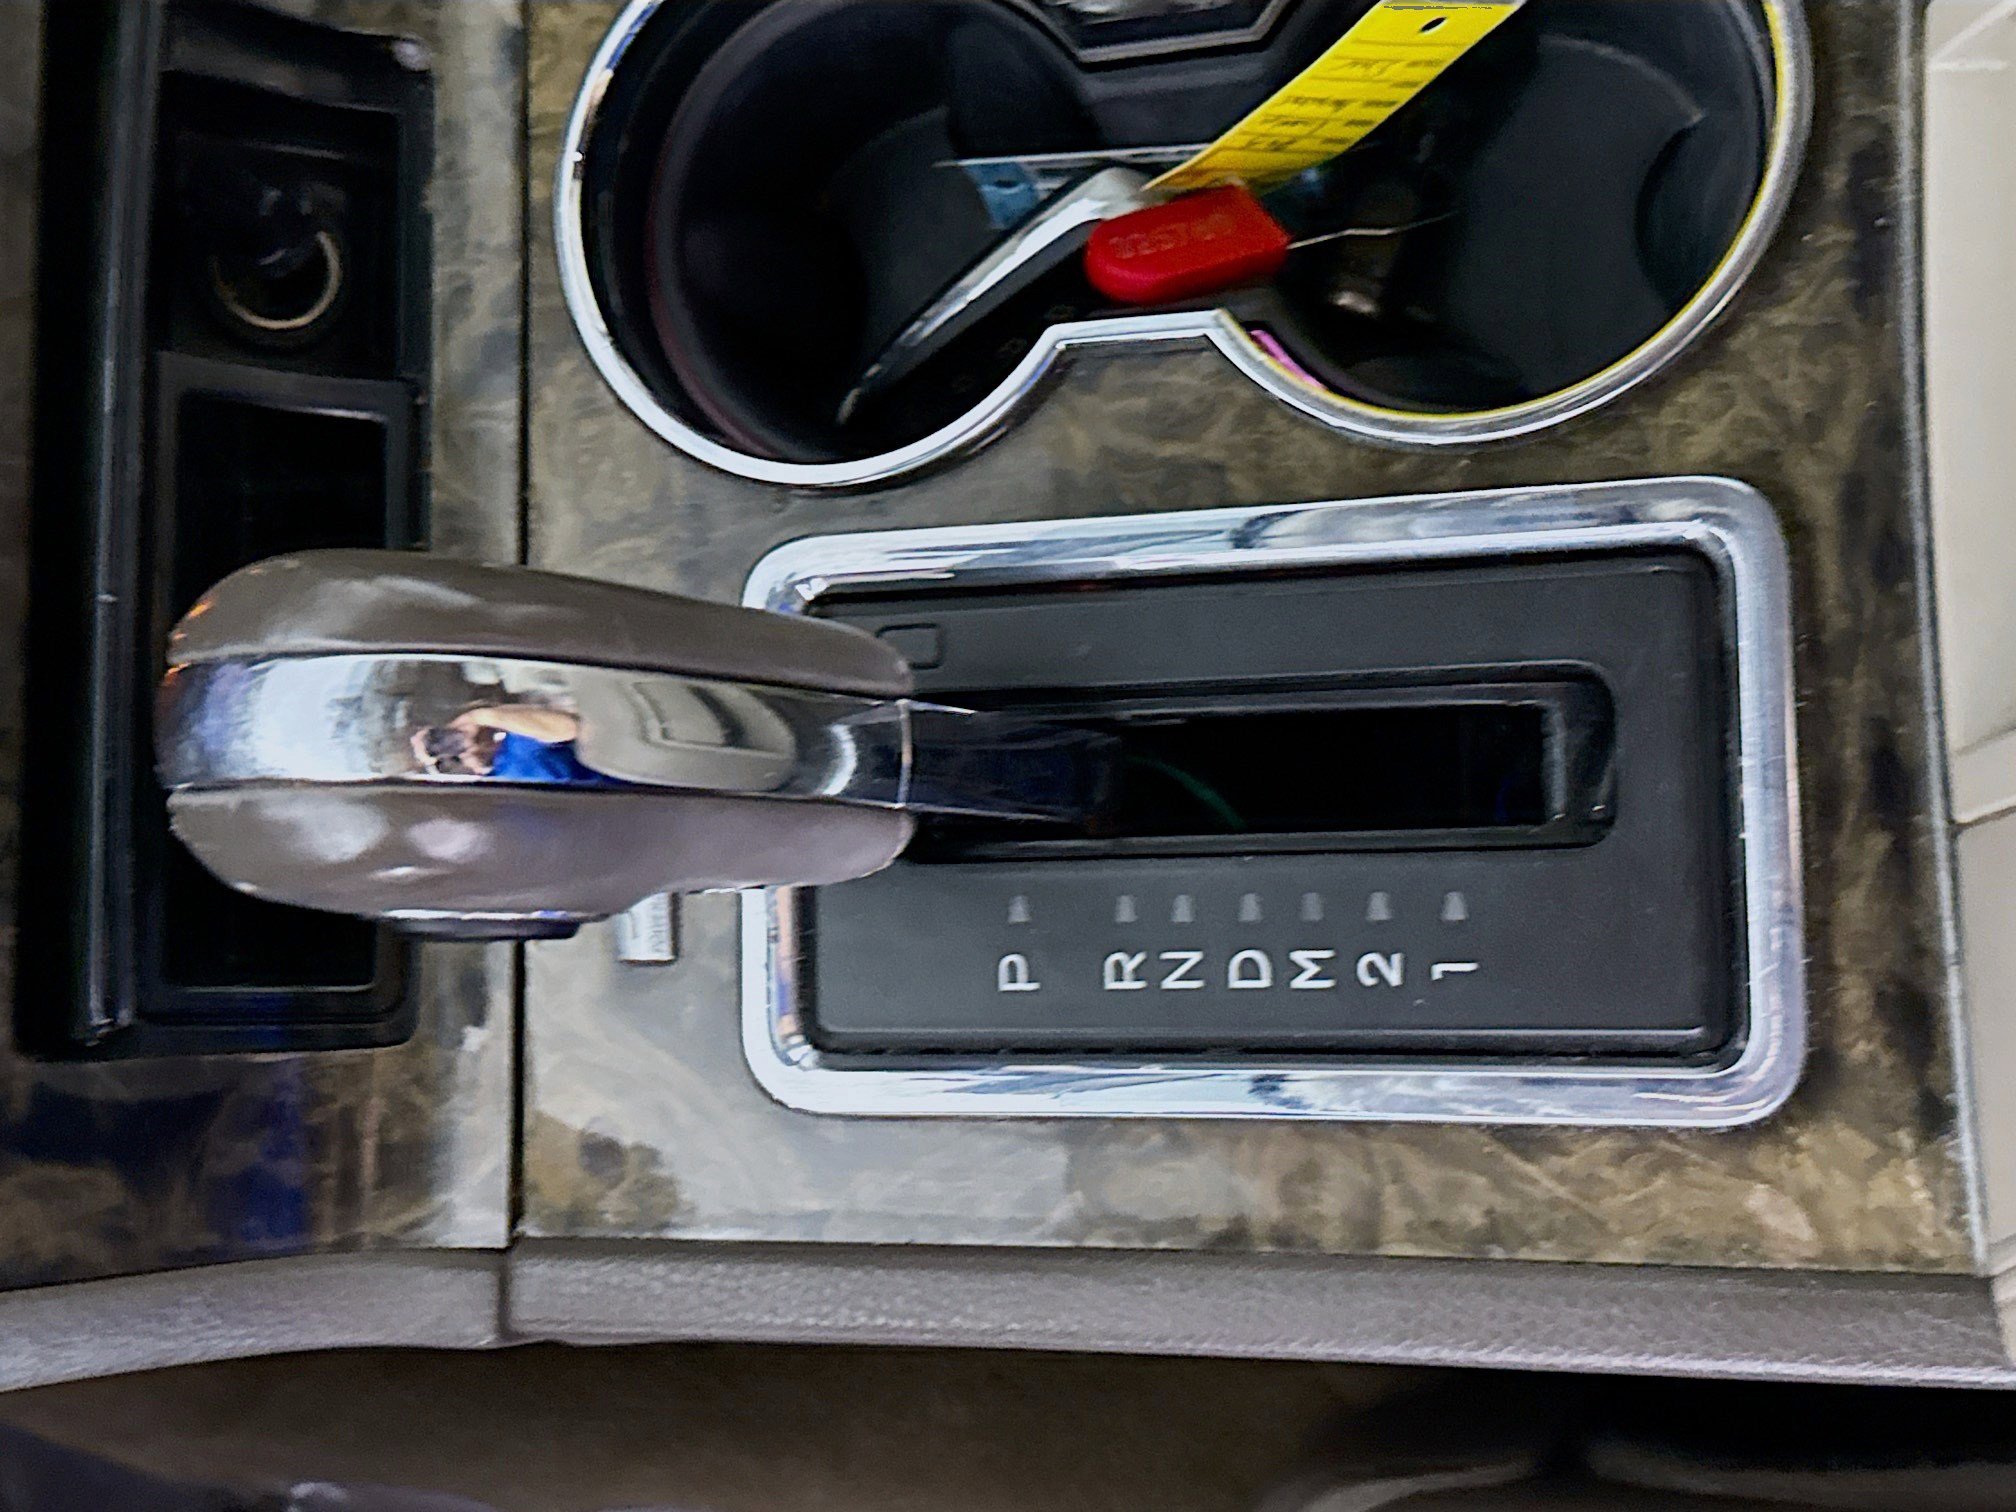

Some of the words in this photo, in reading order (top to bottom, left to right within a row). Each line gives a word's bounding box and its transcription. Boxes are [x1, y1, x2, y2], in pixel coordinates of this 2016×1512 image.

[997, 953, 1041, 992] P
[1102, 951, 1148, 990] R
[1159, 950, 1205, 990] N
[1227, 949, 1273, 989] D
[1289, 949, 1336, 989] M
[1356, 952, 1404, 987] 2
[1431, 962, 1480, 981] 1
